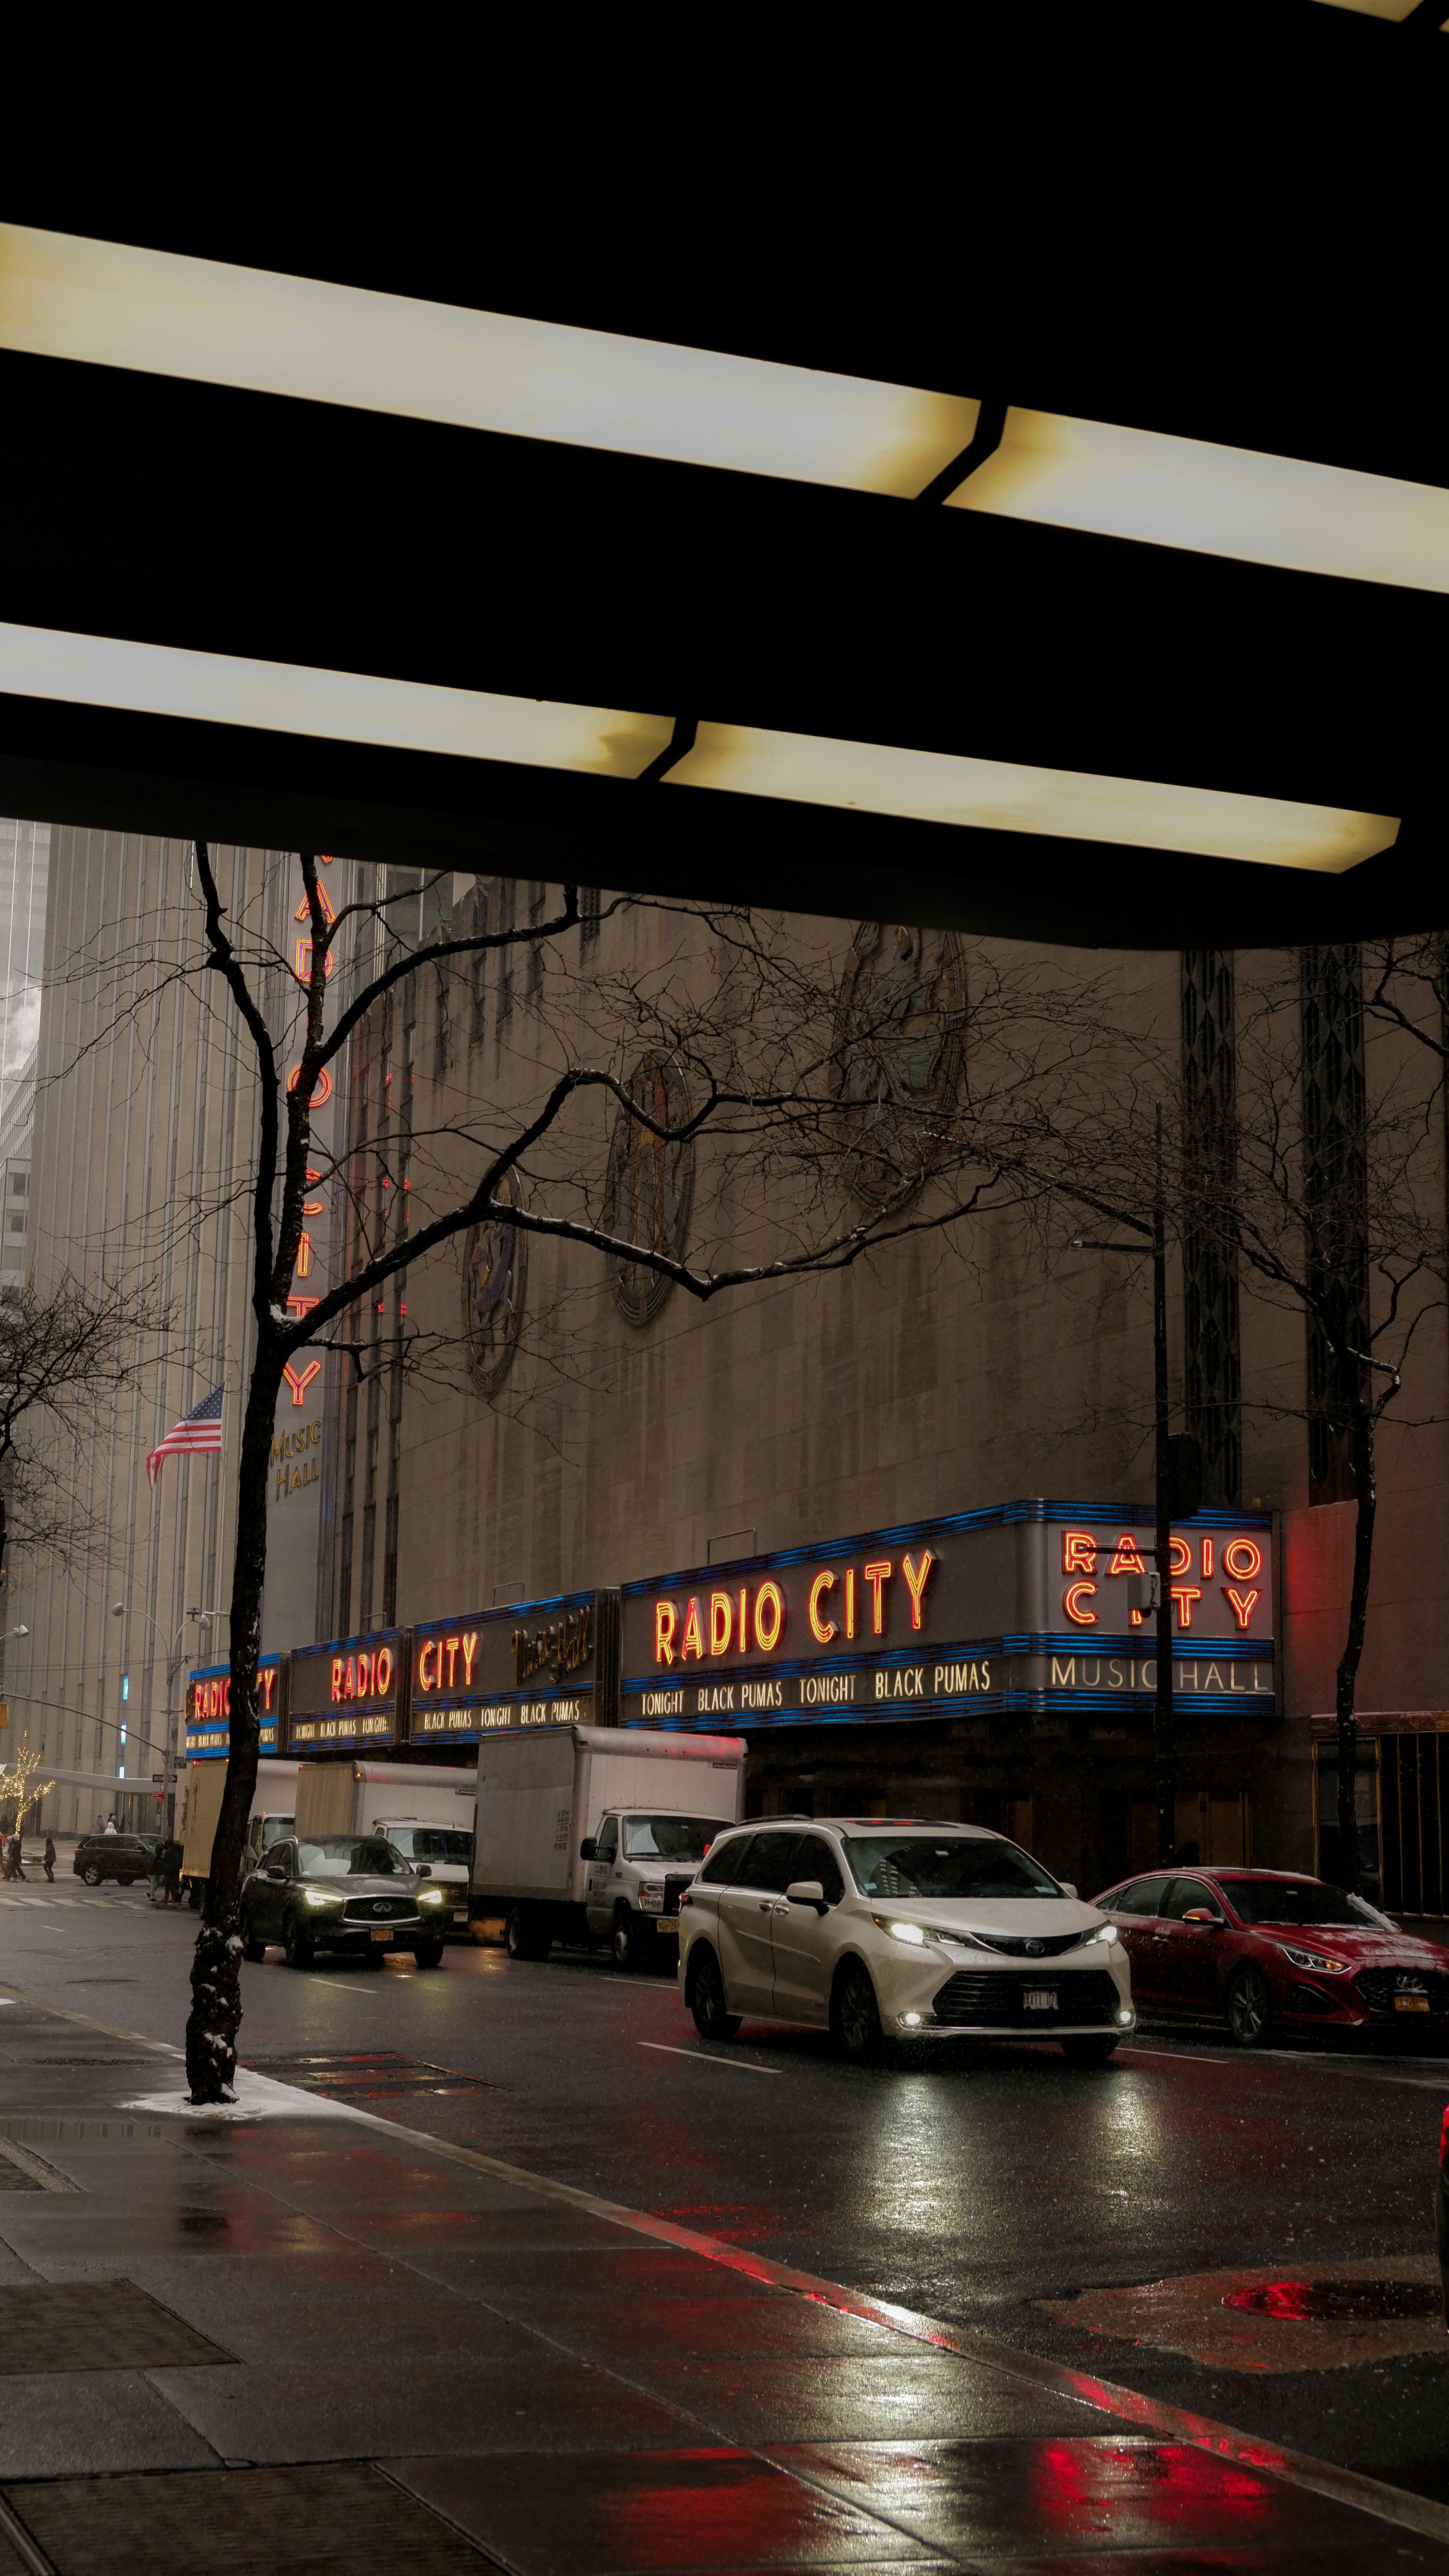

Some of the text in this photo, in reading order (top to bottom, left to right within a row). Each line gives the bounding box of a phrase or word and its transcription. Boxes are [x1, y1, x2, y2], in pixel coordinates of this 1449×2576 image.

[276, 1458, 319, 1502] HALL
[655, 1549, 937, 1665] RADIO CITY
[332, 1648, 392, 1703] RADIO
[420, 1631, 477, 1691] CITY
[642, 1661, 990, 1715] TONIGHT BLACK PUMAS TONIGHT BLACK PUMAS
[1180, 1662, 1269, 1691] HALL
[321, 1721, 336, 1738] BLACK
[339, 1719, 356, 1736] PUMAS
[424, 1700, 579, 1730] BLACK PUMAS TONIGHT BLACK PUMAS
